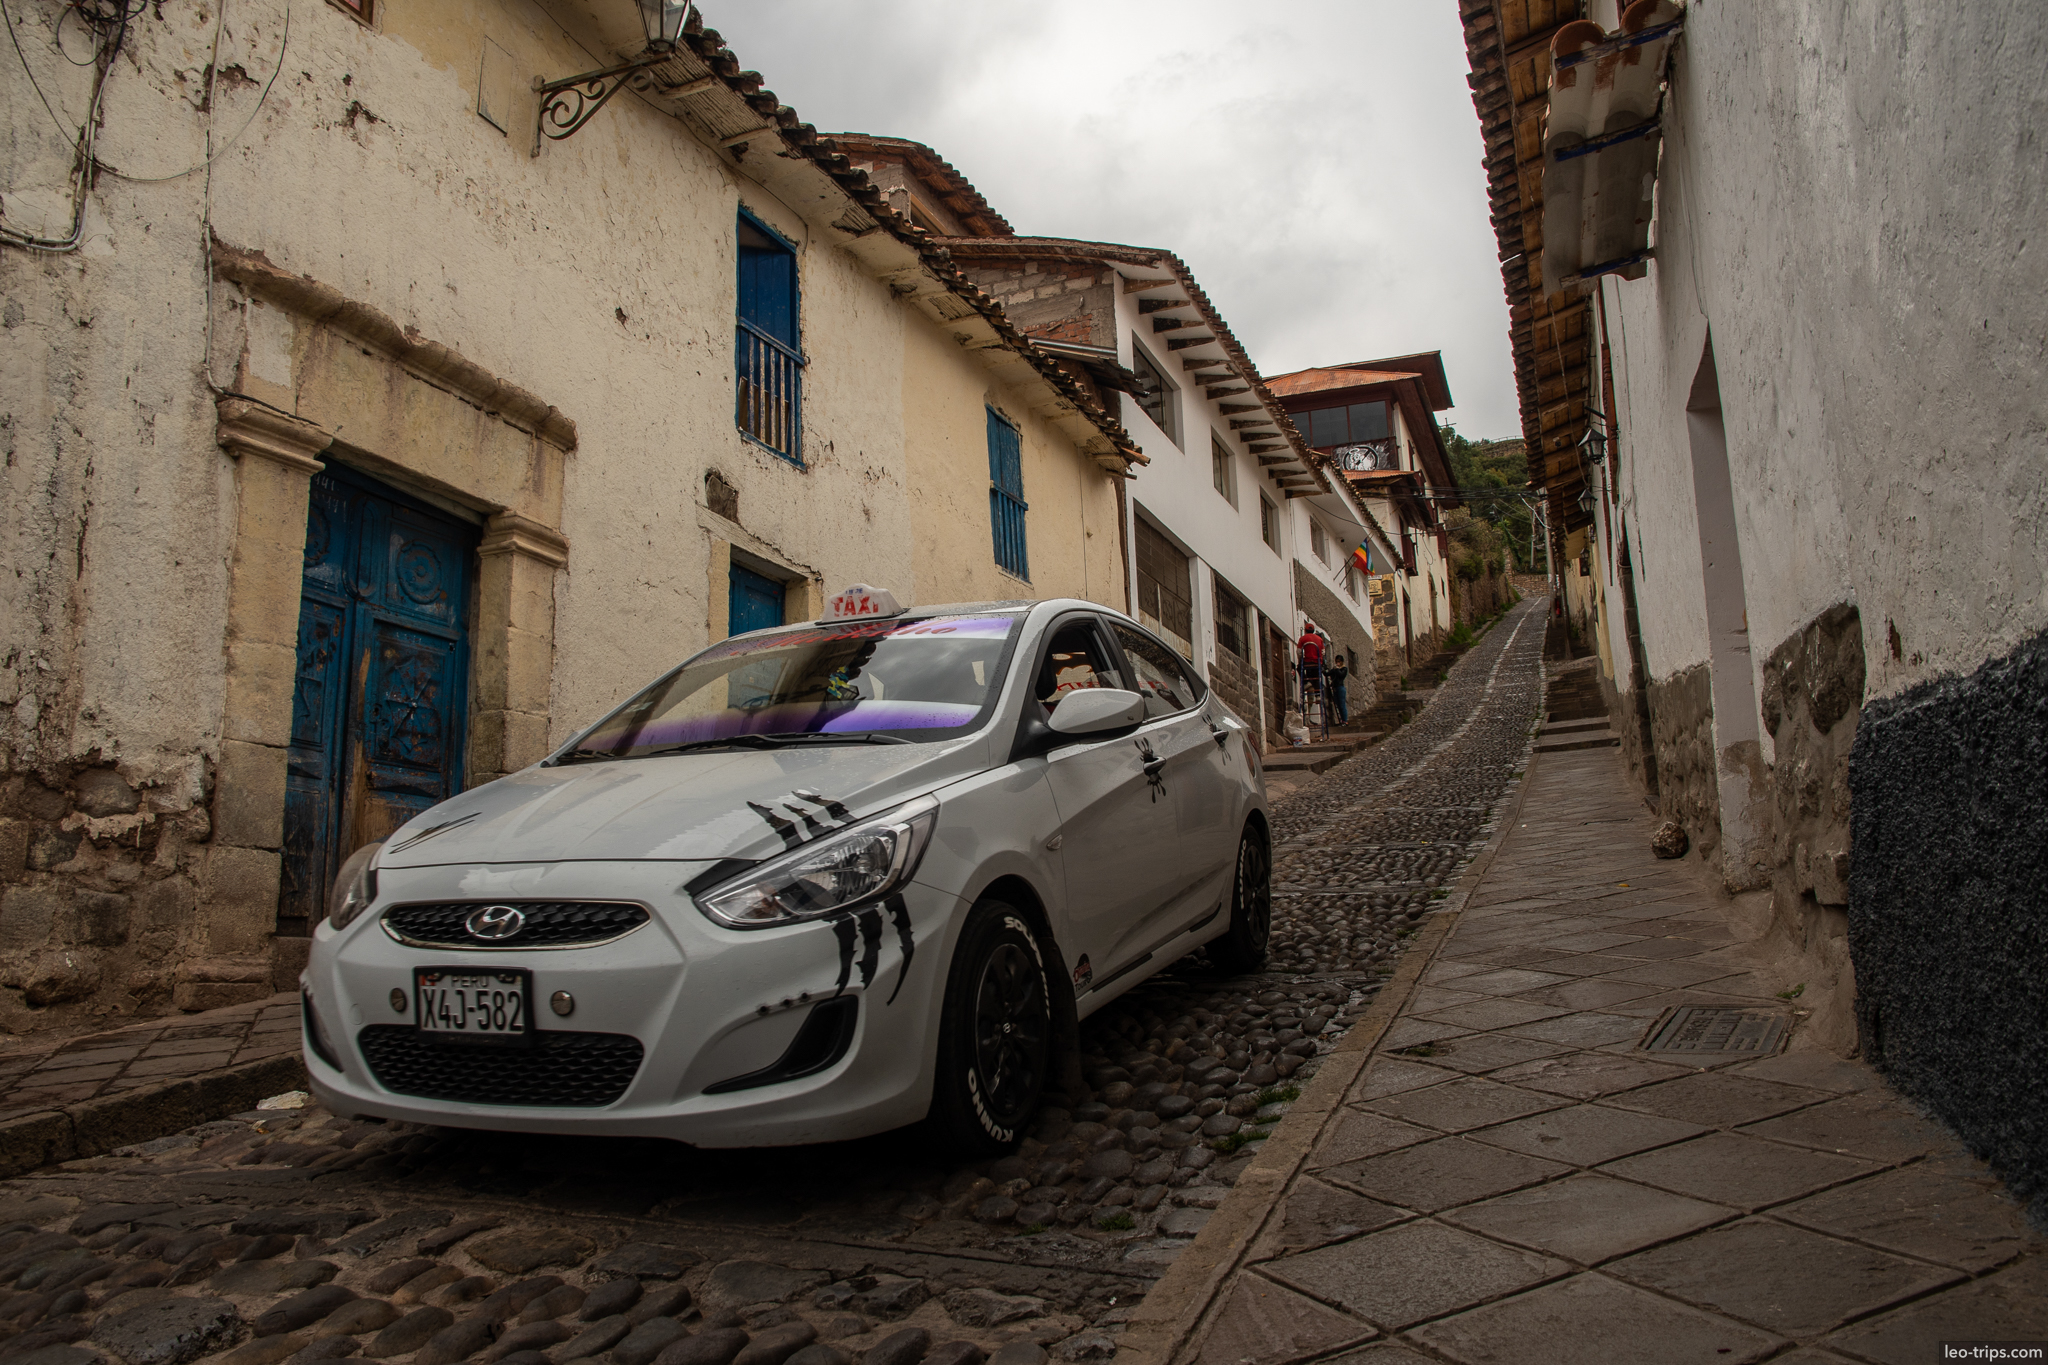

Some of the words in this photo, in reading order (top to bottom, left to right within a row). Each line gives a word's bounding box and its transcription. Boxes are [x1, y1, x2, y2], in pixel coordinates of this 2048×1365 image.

[831, 595, 879, 617] TAXI
[452, 976, 490, 987] PERU
[423, 988, 524, 1031] X4J-582
[967, 1067, 1014, 1143] KUMHO
